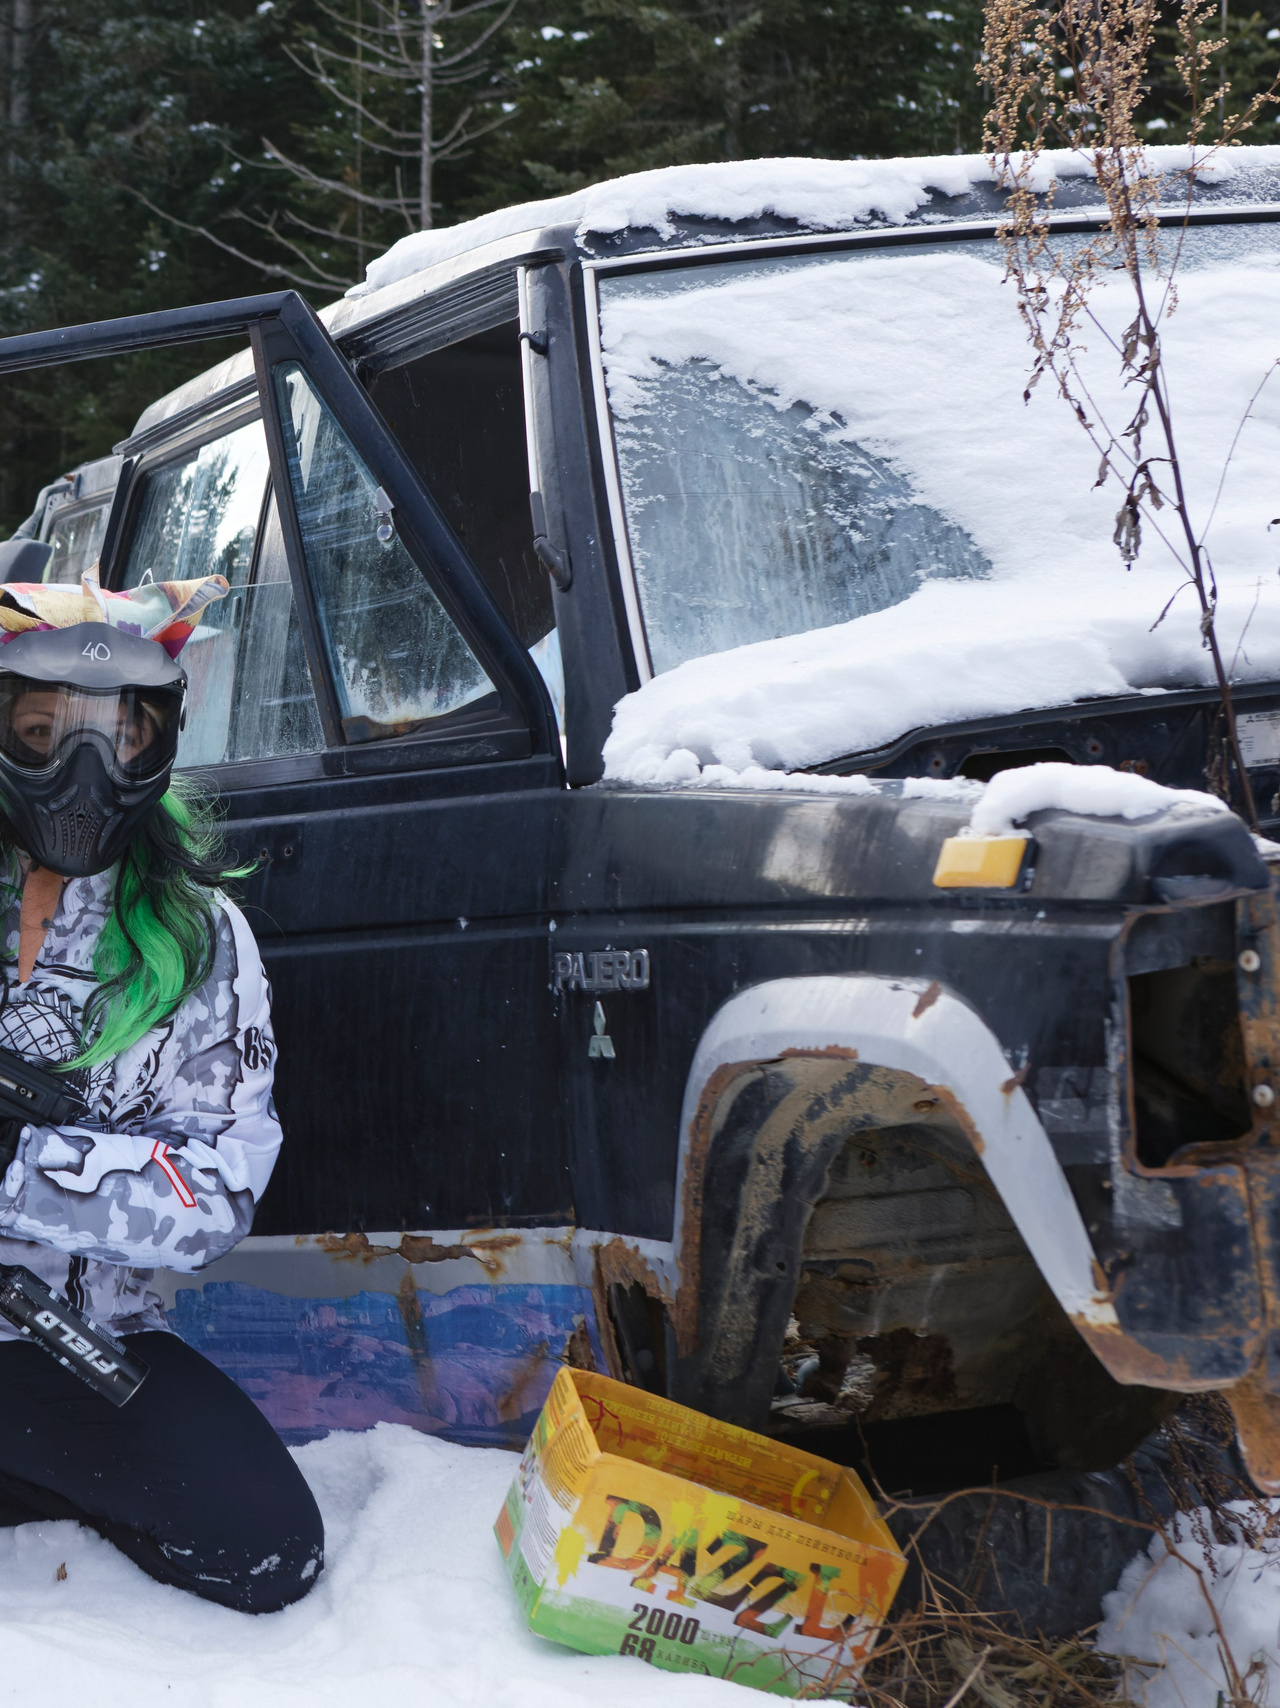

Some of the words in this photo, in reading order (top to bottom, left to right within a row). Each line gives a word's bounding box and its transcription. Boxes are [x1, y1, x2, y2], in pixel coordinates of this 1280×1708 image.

[81, 641, 111, 661] 40
[554, 949, 650, 990] PAJERO
[33, 1309, 120, 1375] FIELD
[726, 1510, 763, 1530] ШАРЫ
[628, 1603, 701, 1645] 2000
[619, 1632, 657, 1664] 68
